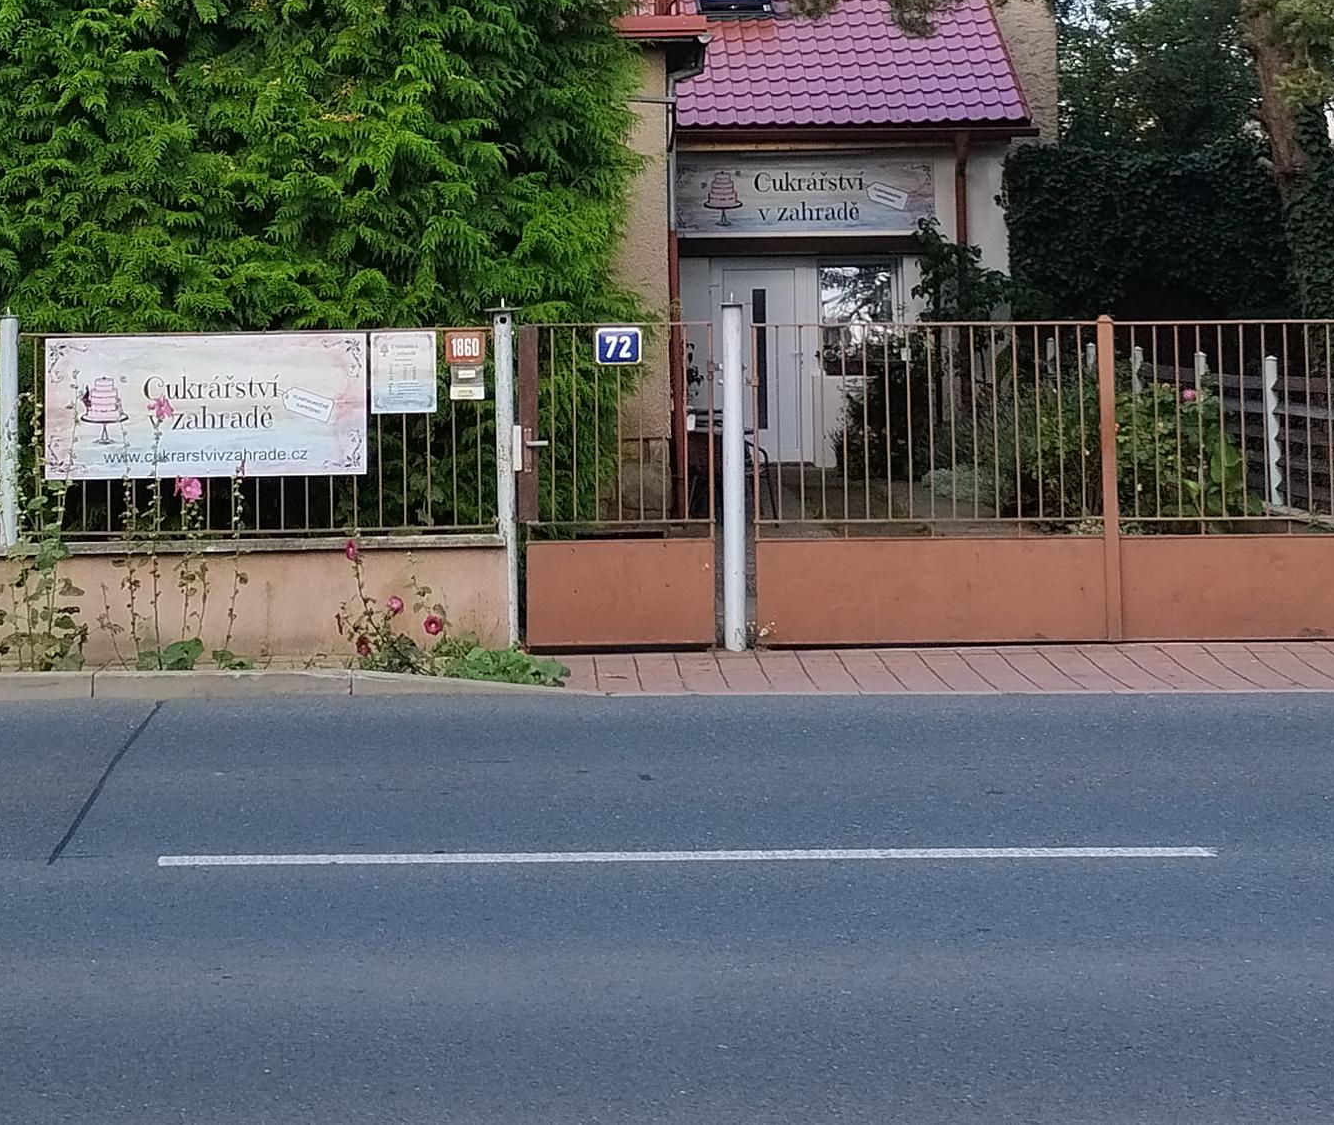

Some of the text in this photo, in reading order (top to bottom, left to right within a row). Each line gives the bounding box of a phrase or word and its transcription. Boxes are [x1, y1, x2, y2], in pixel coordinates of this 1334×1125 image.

[754, 171, 865, 193] Cukrářství
[758, 201, 860, 222] v zahradě
[451, 337, 480, 358] 1860
[605, 335, 633, 359] 72
[143, 374, 280, 400] Cukrářství
[171, 405, 273, 430] zahradě
